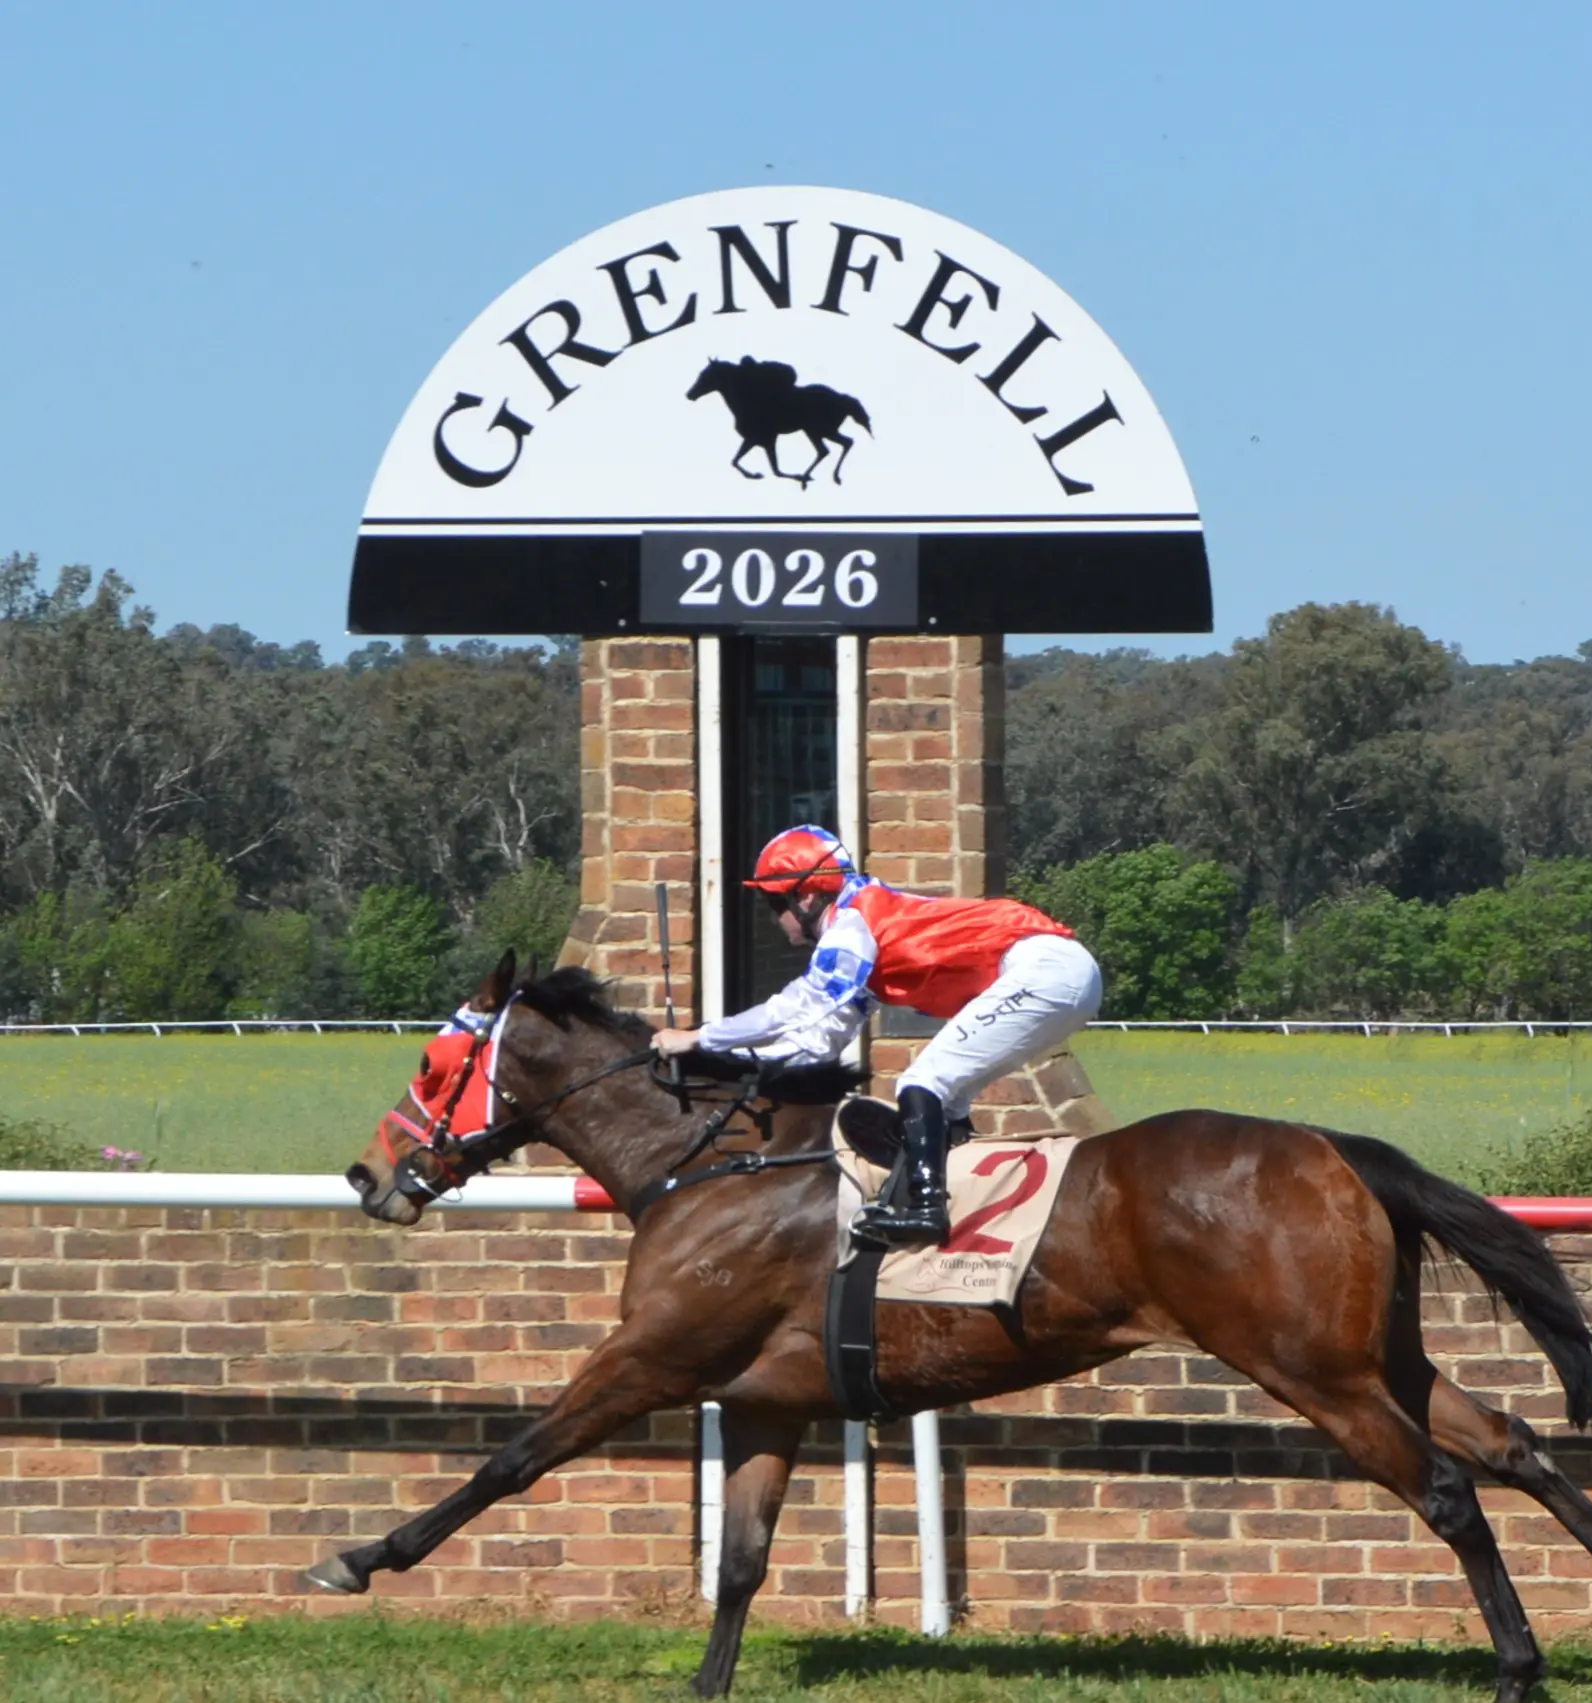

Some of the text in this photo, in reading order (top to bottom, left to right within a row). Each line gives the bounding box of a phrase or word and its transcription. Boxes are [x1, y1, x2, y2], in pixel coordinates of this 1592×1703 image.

[433, 220, 1125, 496] GRENFELL
[679, 548, 879, 607] 2026
[937, 1149, 1048, 1254] 2
[962, 1275, 997, 1288] Centr
